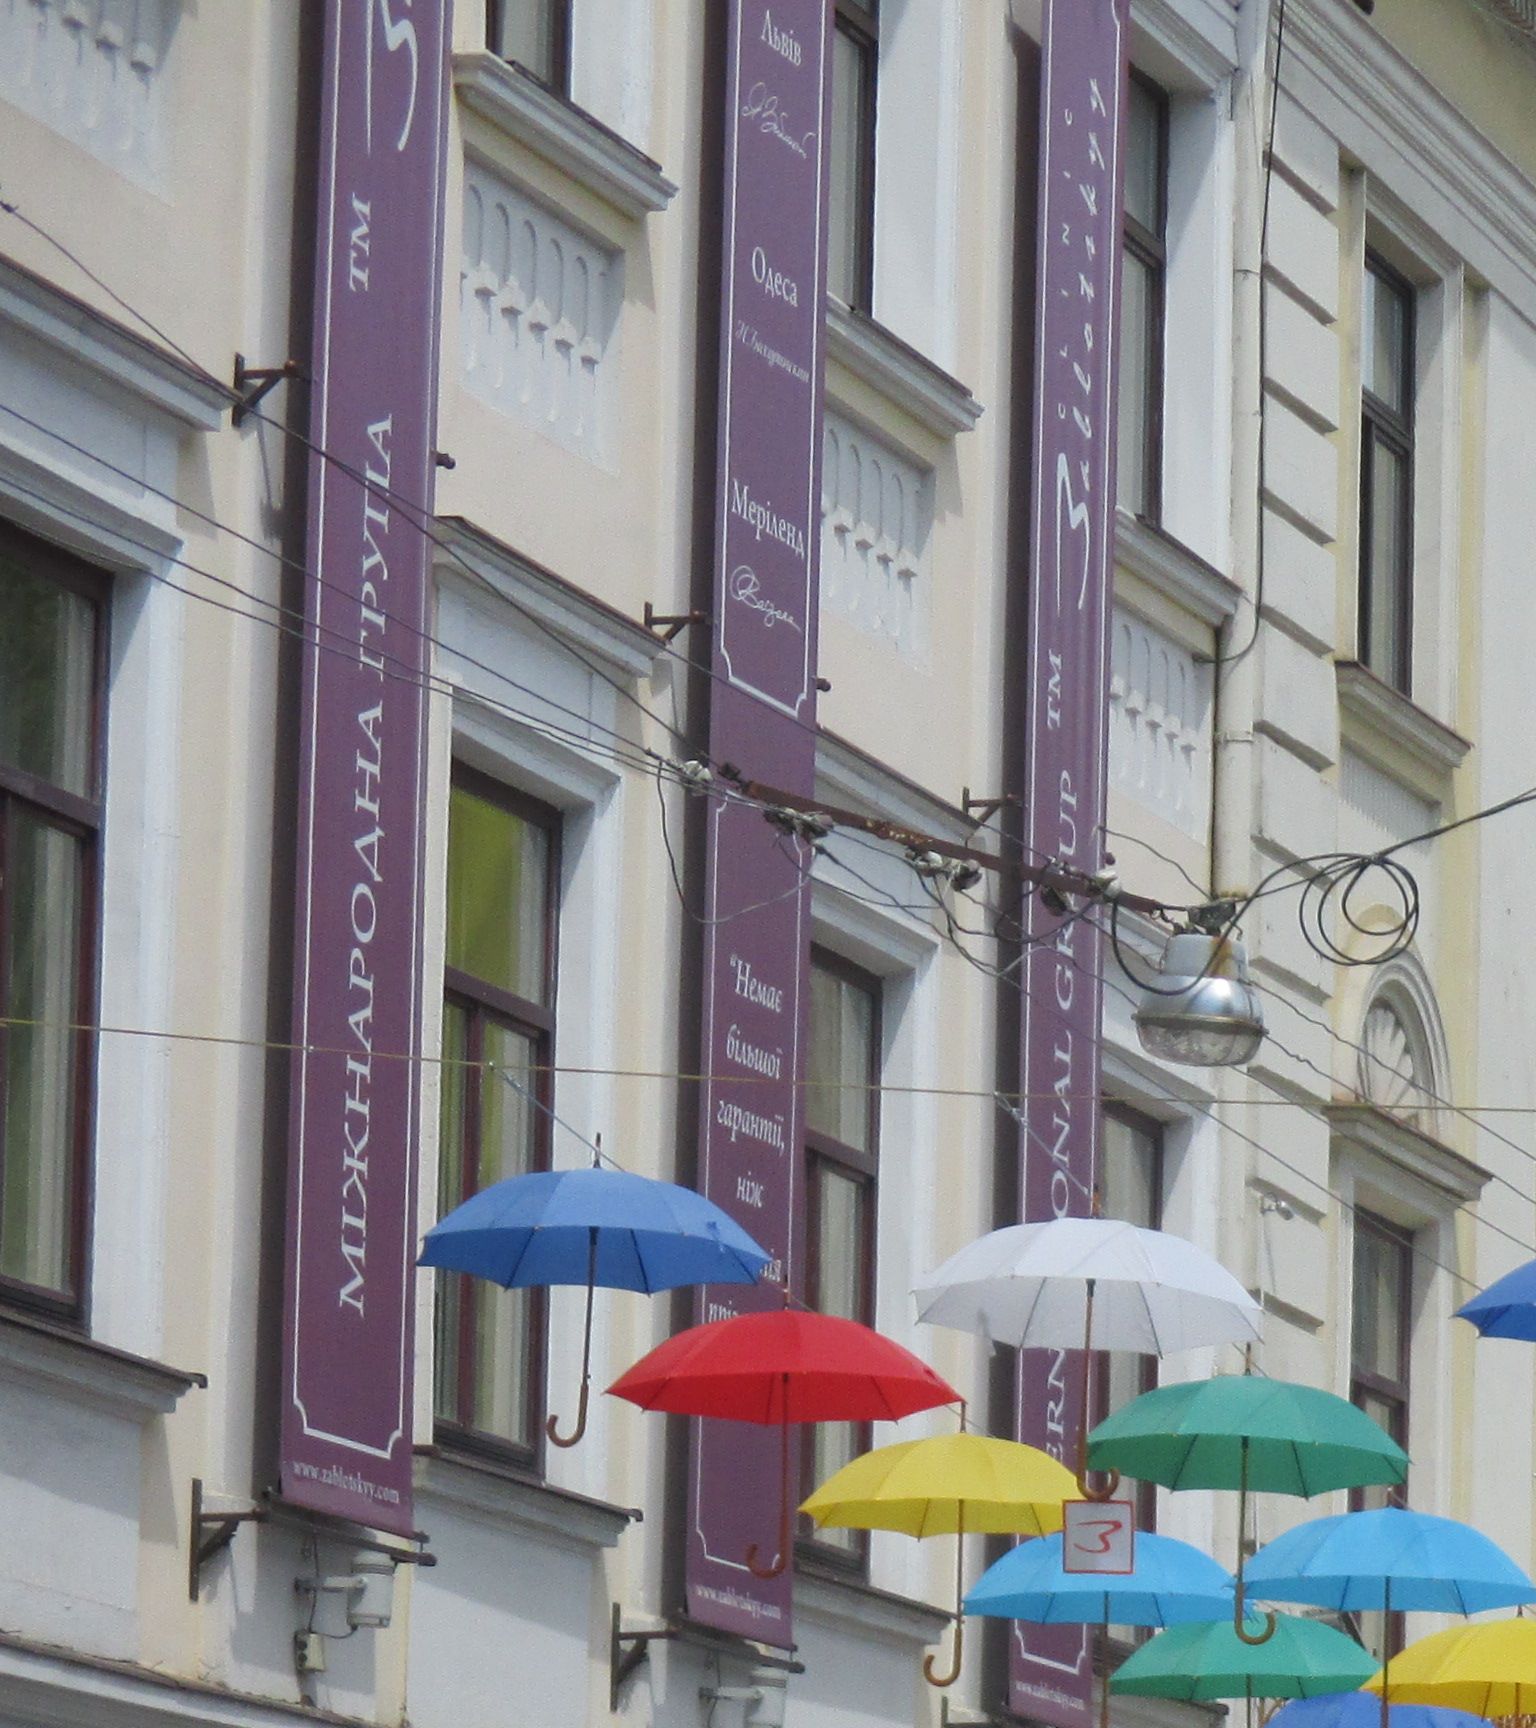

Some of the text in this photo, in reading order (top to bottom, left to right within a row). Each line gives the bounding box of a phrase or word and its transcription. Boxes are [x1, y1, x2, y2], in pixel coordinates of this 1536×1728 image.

[360, 413, 393, 682] ГРУПА
[340, 701, 385, 1319] МІЖНАРОДНА
[736, 1171, 765, 1209] ніж
